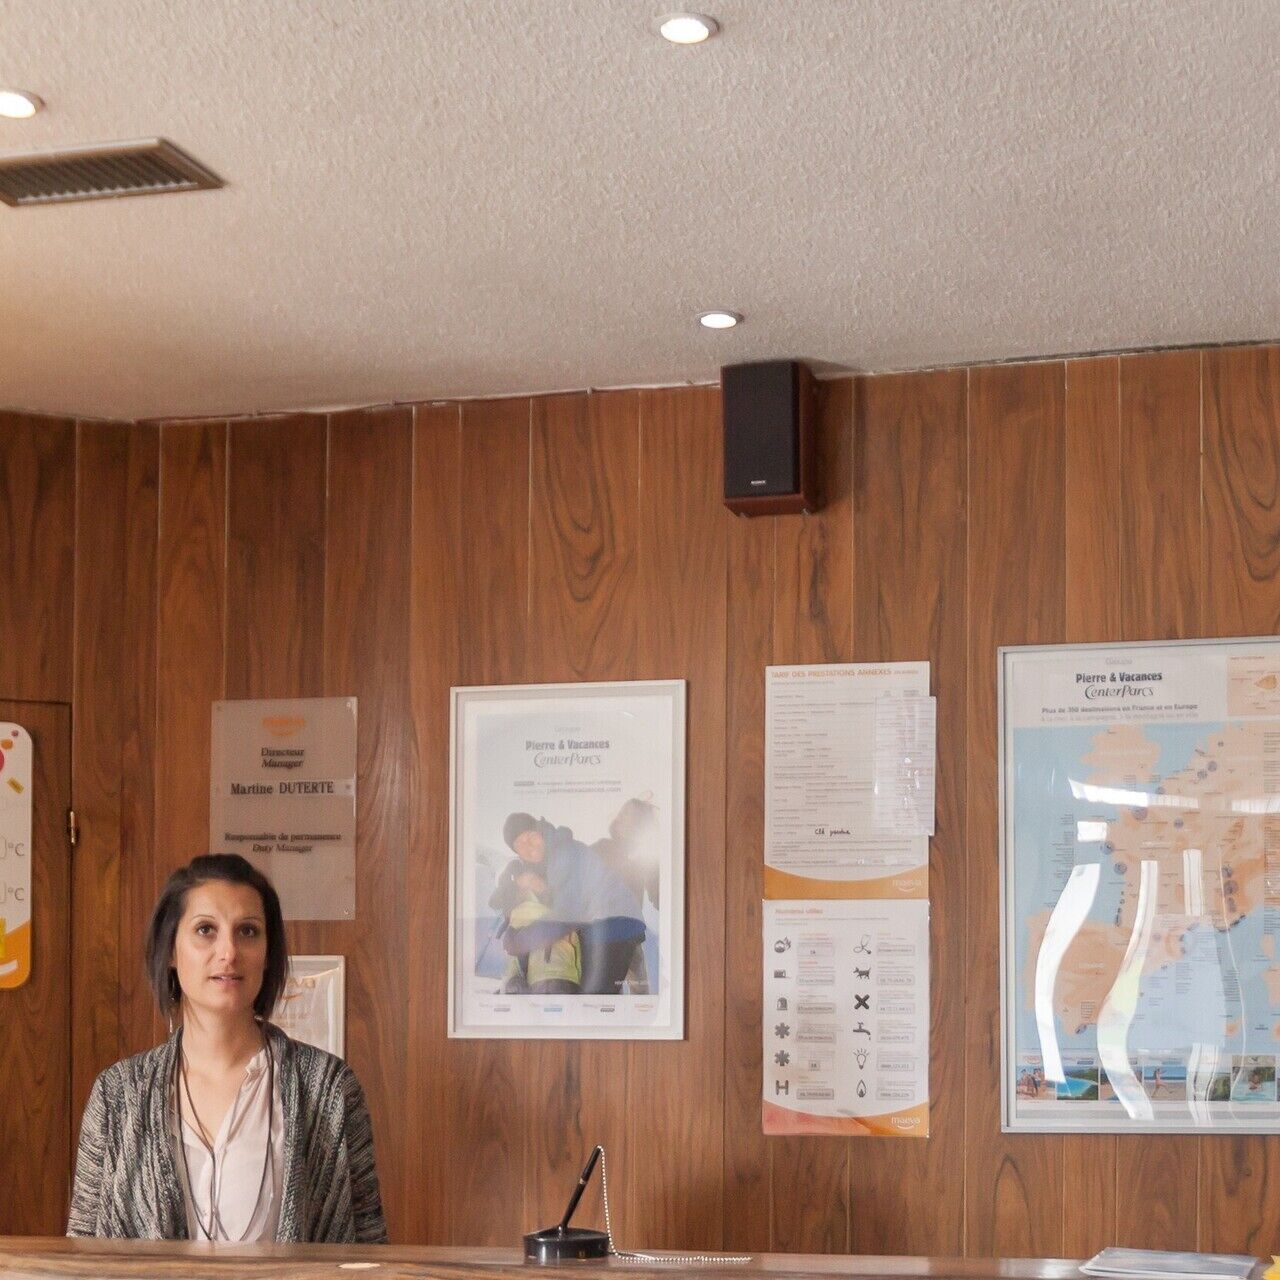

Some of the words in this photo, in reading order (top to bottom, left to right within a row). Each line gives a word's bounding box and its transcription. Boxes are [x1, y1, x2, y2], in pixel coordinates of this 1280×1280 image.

[1076, 673, 1106, 683] Pierre
[1109, 672, 1117, 682] &
[1119, 671, 1163, 682] Vacances
[526, 740, 555, 750] Pierre
[558, 739, 565, 750] &
[568, 739, 610, 750] Vacances
[261, 759, 304, 769] Manager
[230, 783, 273, 795] Martine
[279, 781, 334, 794] DUTERTE
